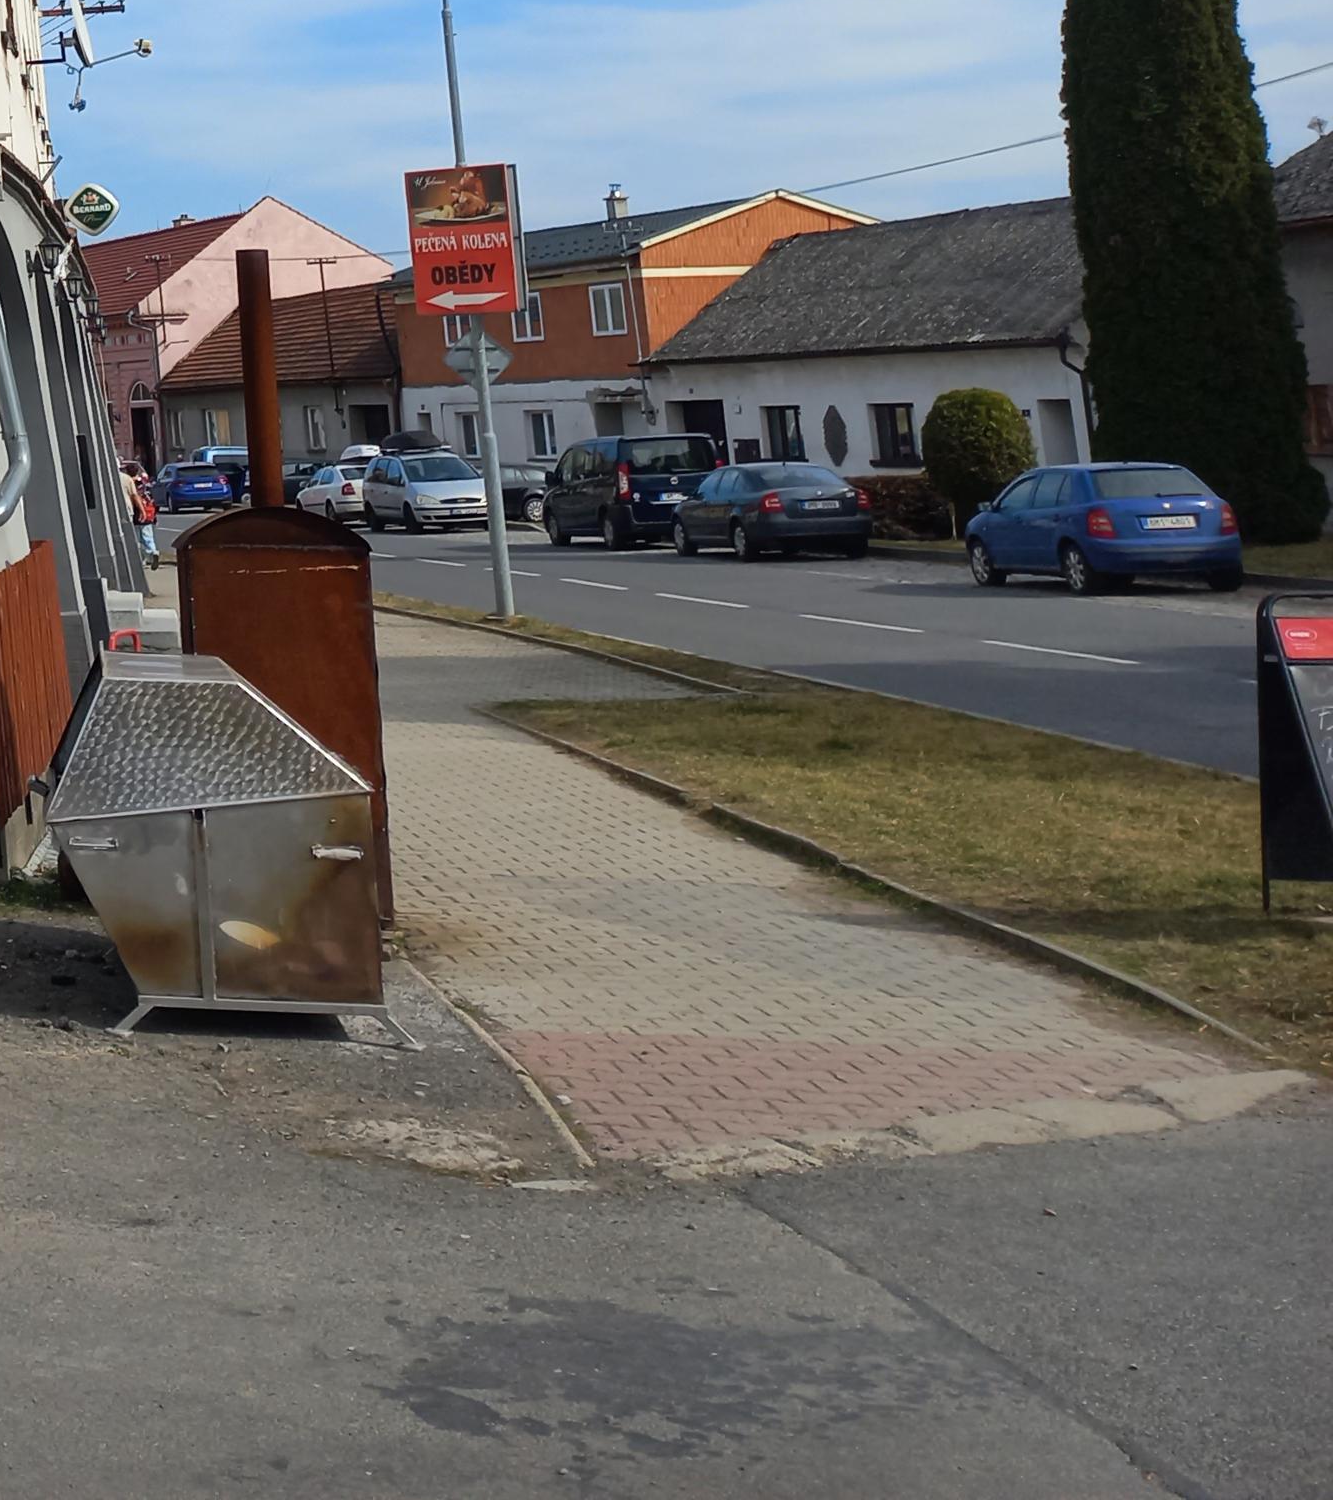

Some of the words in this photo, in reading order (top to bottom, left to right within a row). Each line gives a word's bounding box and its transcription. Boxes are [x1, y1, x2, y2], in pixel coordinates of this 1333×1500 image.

[73, 203, 111, 214] BERNARD
[414, 231, 457, 253] PEČENÁ
[462, 232, 508, 250] KOLENA
[431, 261, 496, 286] OBĚDY
